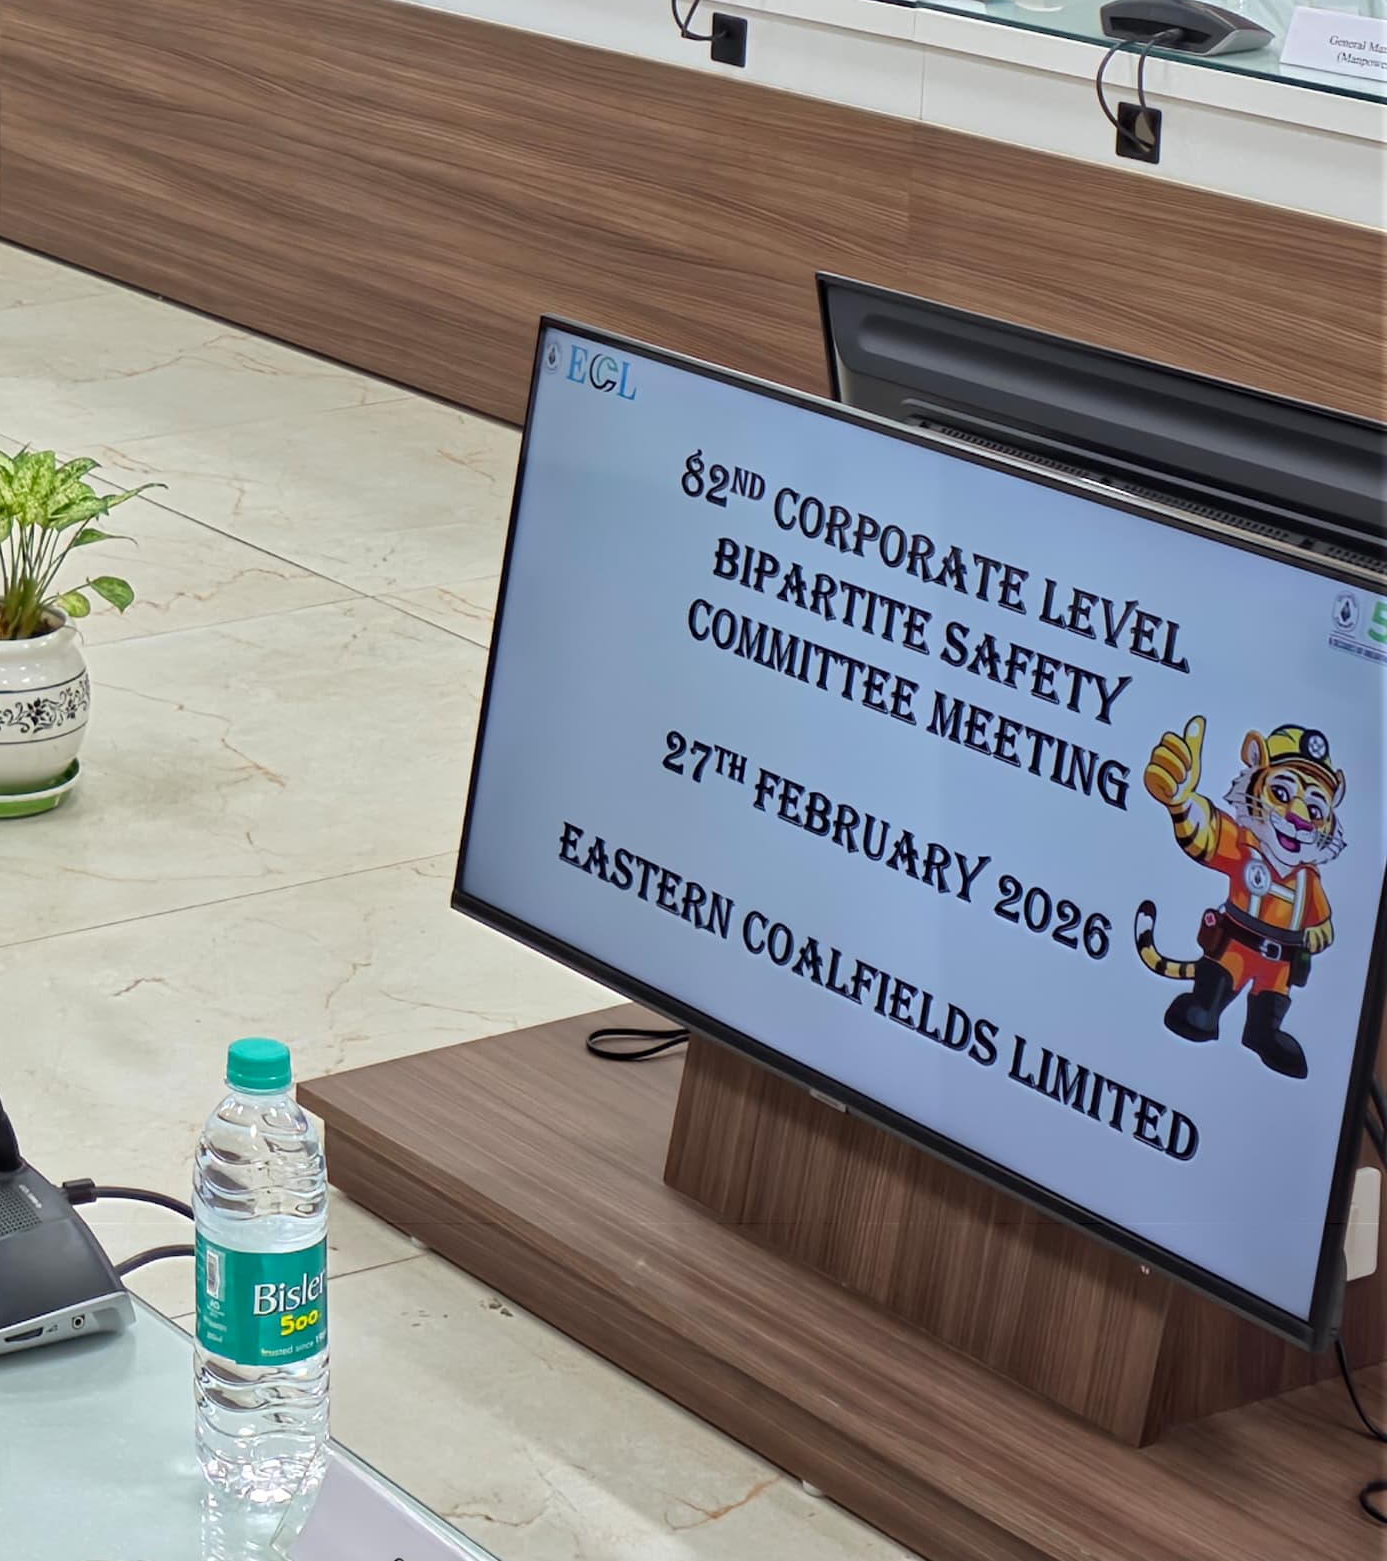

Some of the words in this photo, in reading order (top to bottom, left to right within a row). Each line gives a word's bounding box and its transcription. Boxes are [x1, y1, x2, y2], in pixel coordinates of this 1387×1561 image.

[1329, 35, 1367, 51] General
[565, 345, 638, 401] ECL
[681, 449, 766, 507] 82ND
[773, 487, 1029, 615] CORPORATE
[1039, 578, 1190, 674] LEVEL
[713, 537, 933, 657] BIPARTITE
[940, 620, 1133, 727] SAFETY
[687, 598, 921, 727] COMMITTEE
[927, 689, 1132, 811] MEETING
[661, 730, 748, 784] 27TH
[753, 767, 992, 903] FEBRUARY
[994, 874, 1114, 961] 2026
[558, 821, 735, 941] EASTERN
[742, 910, 999, 1067] COALFIELDS
[1008, 1034, 1200, 1163] LIMITED
[280, 1309, 320, 1336] 500
